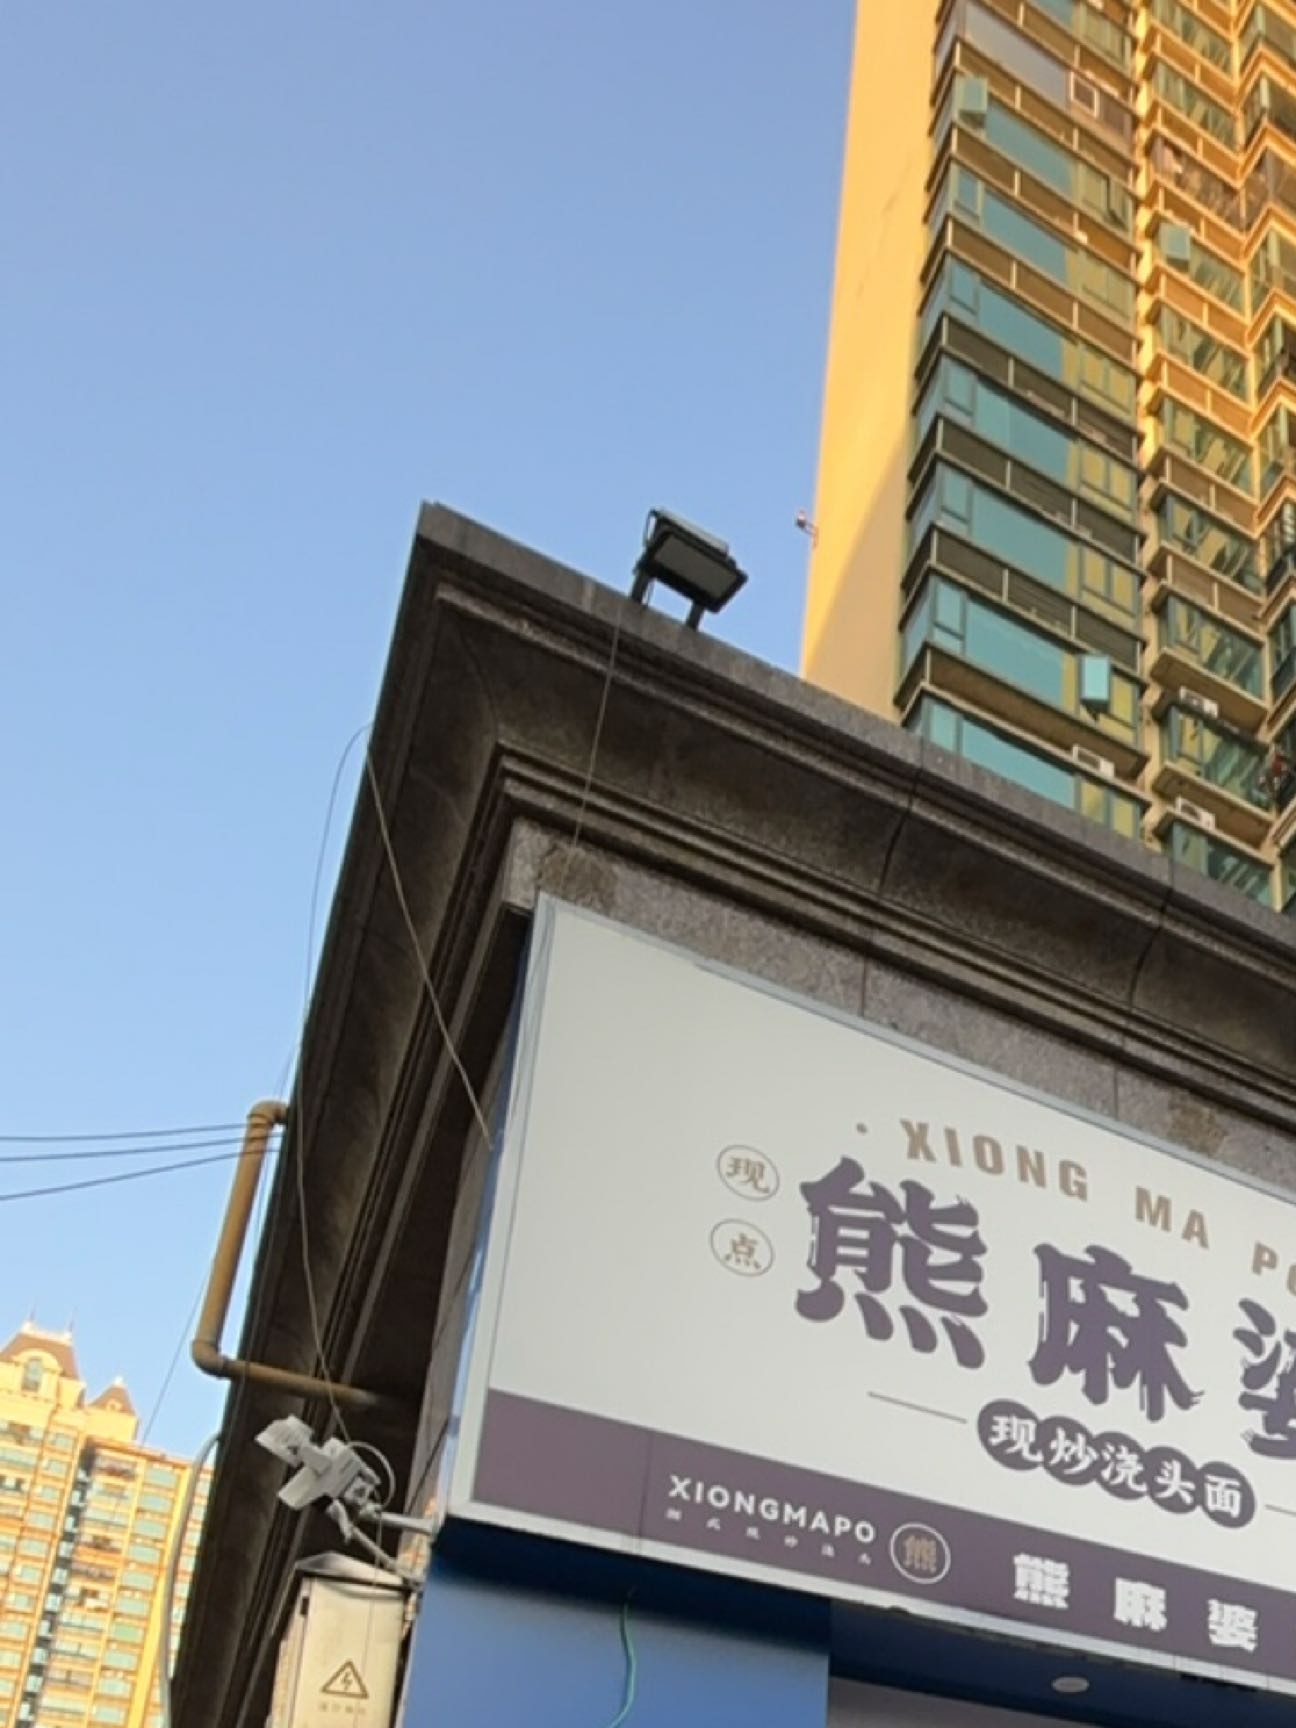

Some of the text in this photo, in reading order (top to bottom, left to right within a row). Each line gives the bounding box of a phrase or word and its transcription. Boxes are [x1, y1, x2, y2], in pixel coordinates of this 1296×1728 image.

[901, 1118, 1090, 1202] XIONG
[1135, 1187, 1210, 1248] MA
[668, 1475, 876, 1543] XIONGMAPO
[985, 1411, 1248, 1520] 现炒浇头面
